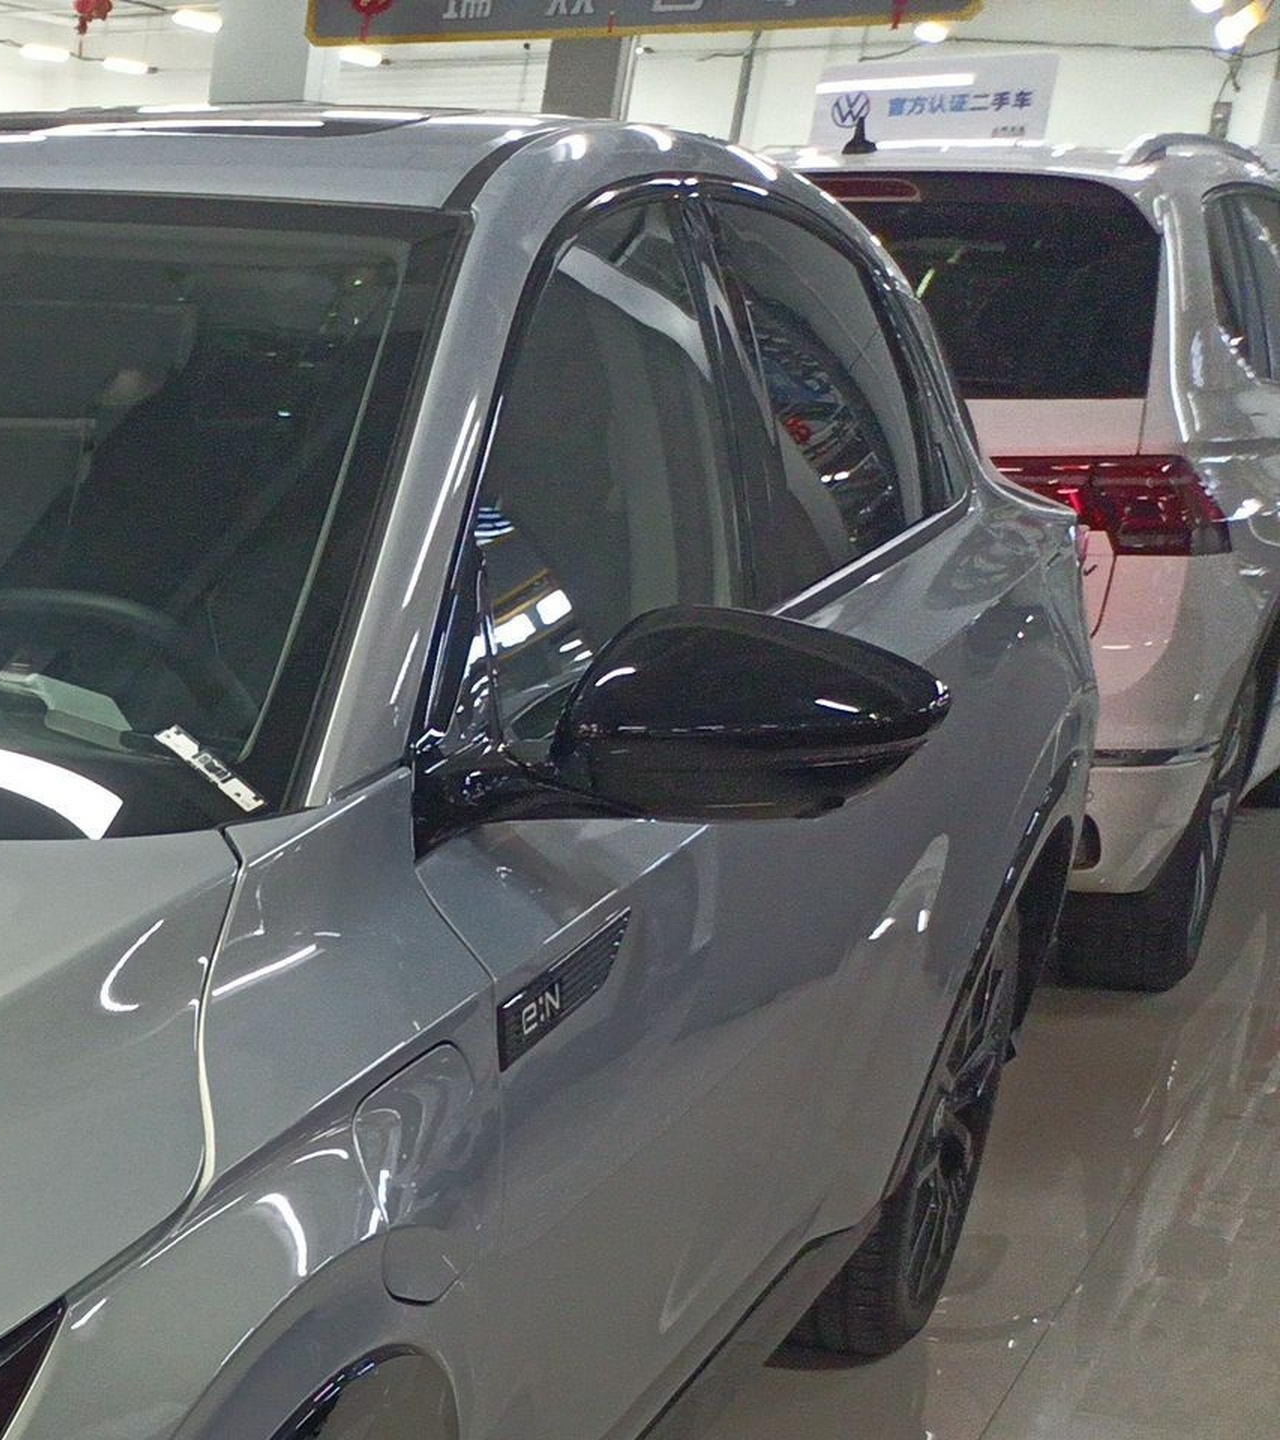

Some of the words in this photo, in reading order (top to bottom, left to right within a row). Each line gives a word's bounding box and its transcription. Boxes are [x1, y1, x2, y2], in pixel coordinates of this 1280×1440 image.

[888, 90, 1034, 118] 官方认证二手车
